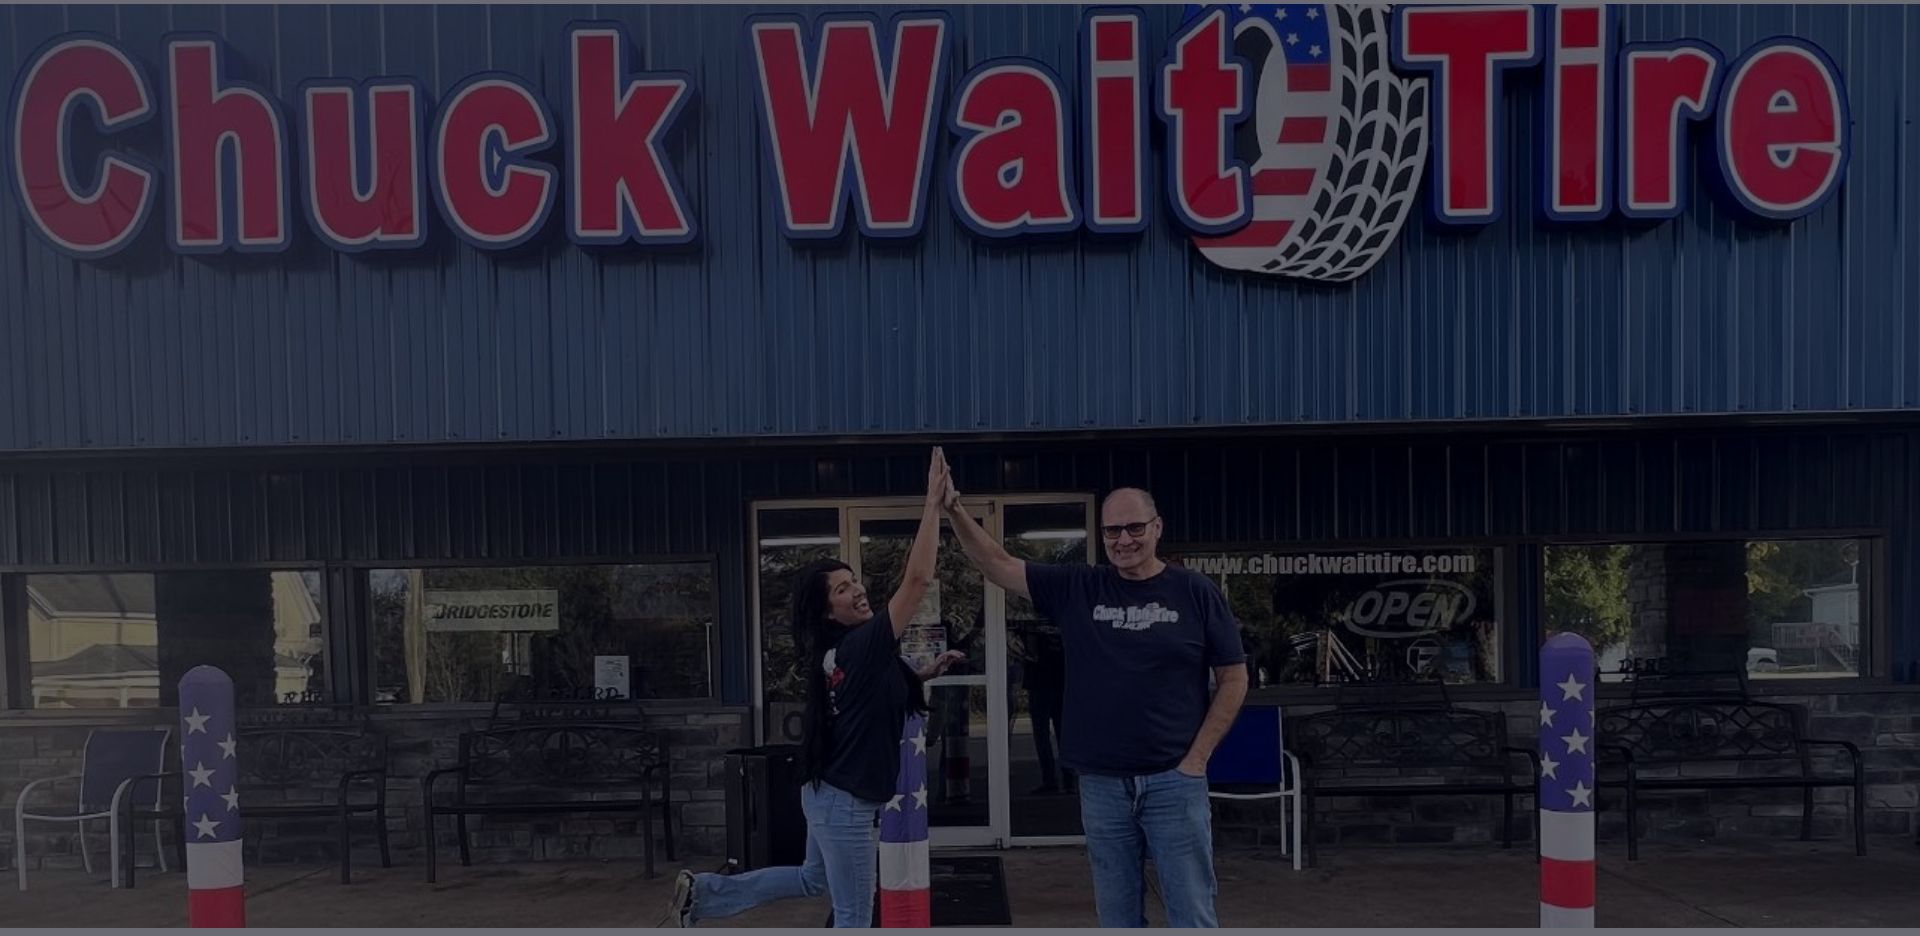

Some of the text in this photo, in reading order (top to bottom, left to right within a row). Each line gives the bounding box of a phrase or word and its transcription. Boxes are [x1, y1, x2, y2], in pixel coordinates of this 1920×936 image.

[13, 4, 1842, 252] Chuck Wait Tire
[1183, 552, 1475, 575] www.chuckwaittire.com
[1351, 588, 1467, 629] OPEN
